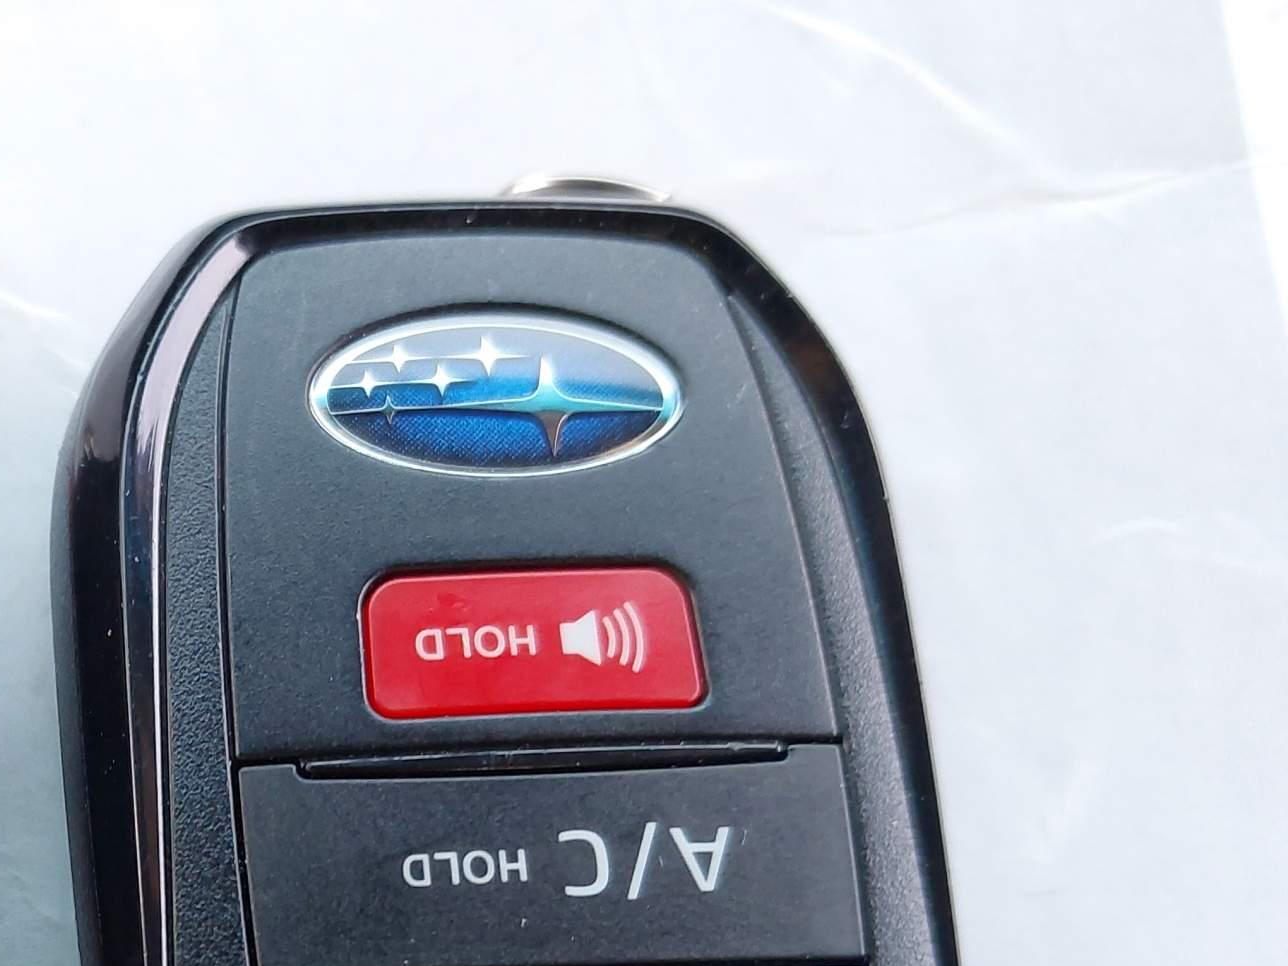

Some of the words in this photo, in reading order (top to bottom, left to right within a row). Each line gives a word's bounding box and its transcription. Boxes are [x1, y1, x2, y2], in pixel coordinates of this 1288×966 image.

[416, 625, 536, 660] HOLD
[402, 849, 528, 887] HOLD
[558, 821, 731, 900] A/C
